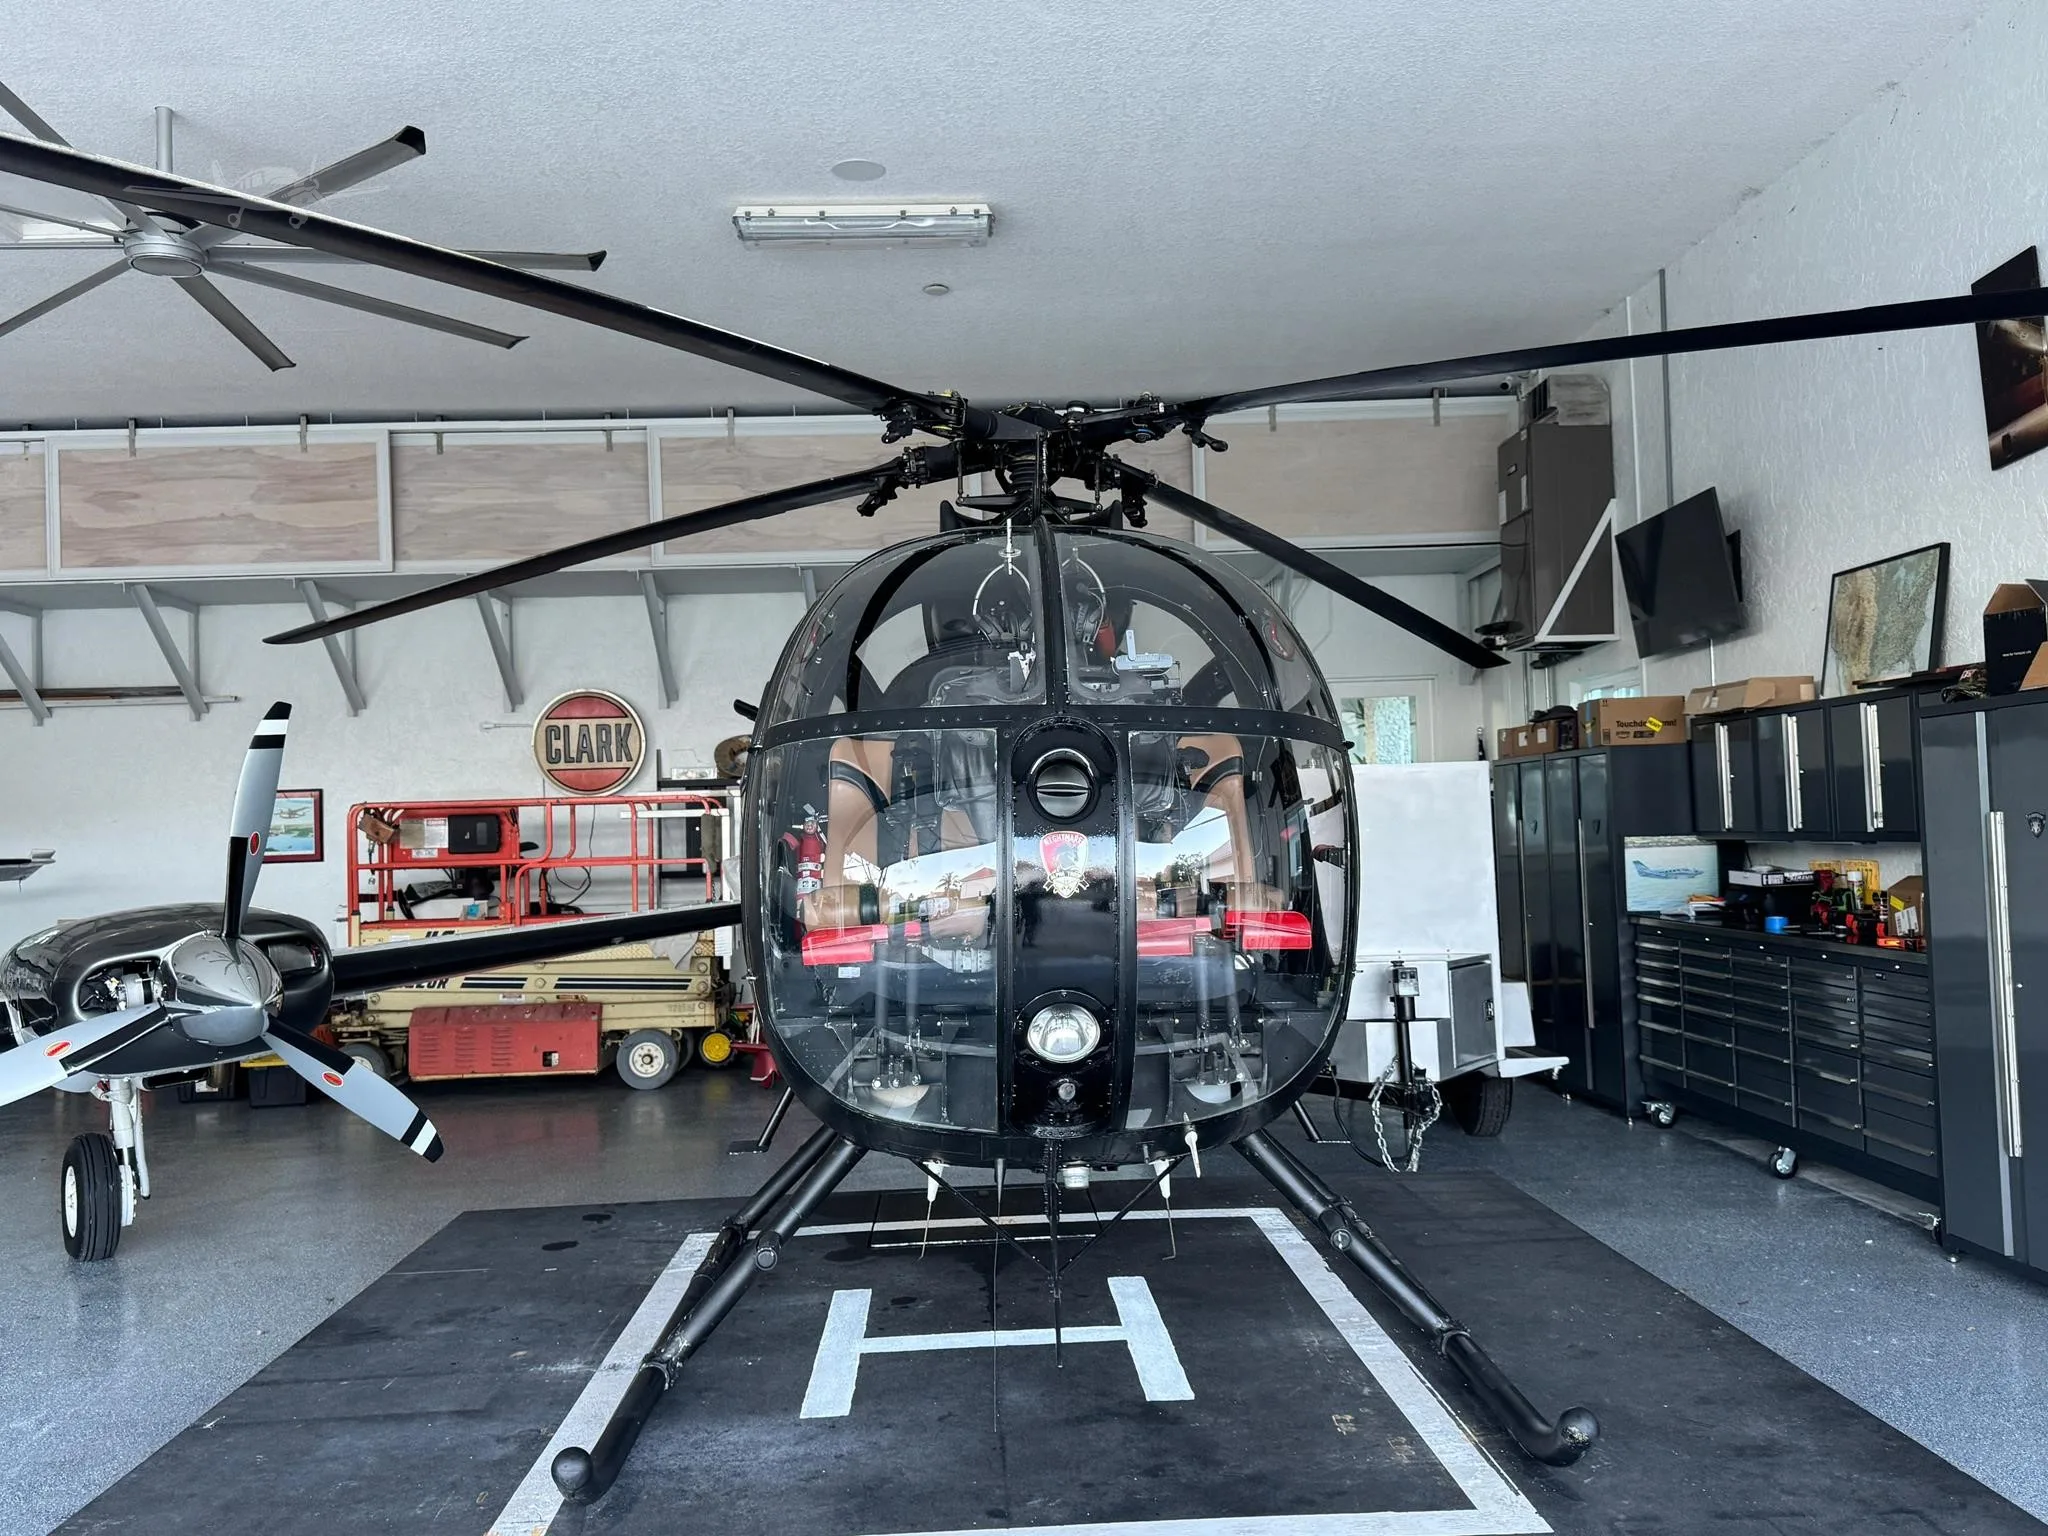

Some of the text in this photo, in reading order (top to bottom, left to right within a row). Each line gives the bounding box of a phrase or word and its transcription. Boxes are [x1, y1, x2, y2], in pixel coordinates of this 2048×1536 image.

[545, 723, 633, 764] CLARK
[1043, 833, 1086, 845] NIGHTMARE
[800, 1275, 1195, 1419] H
